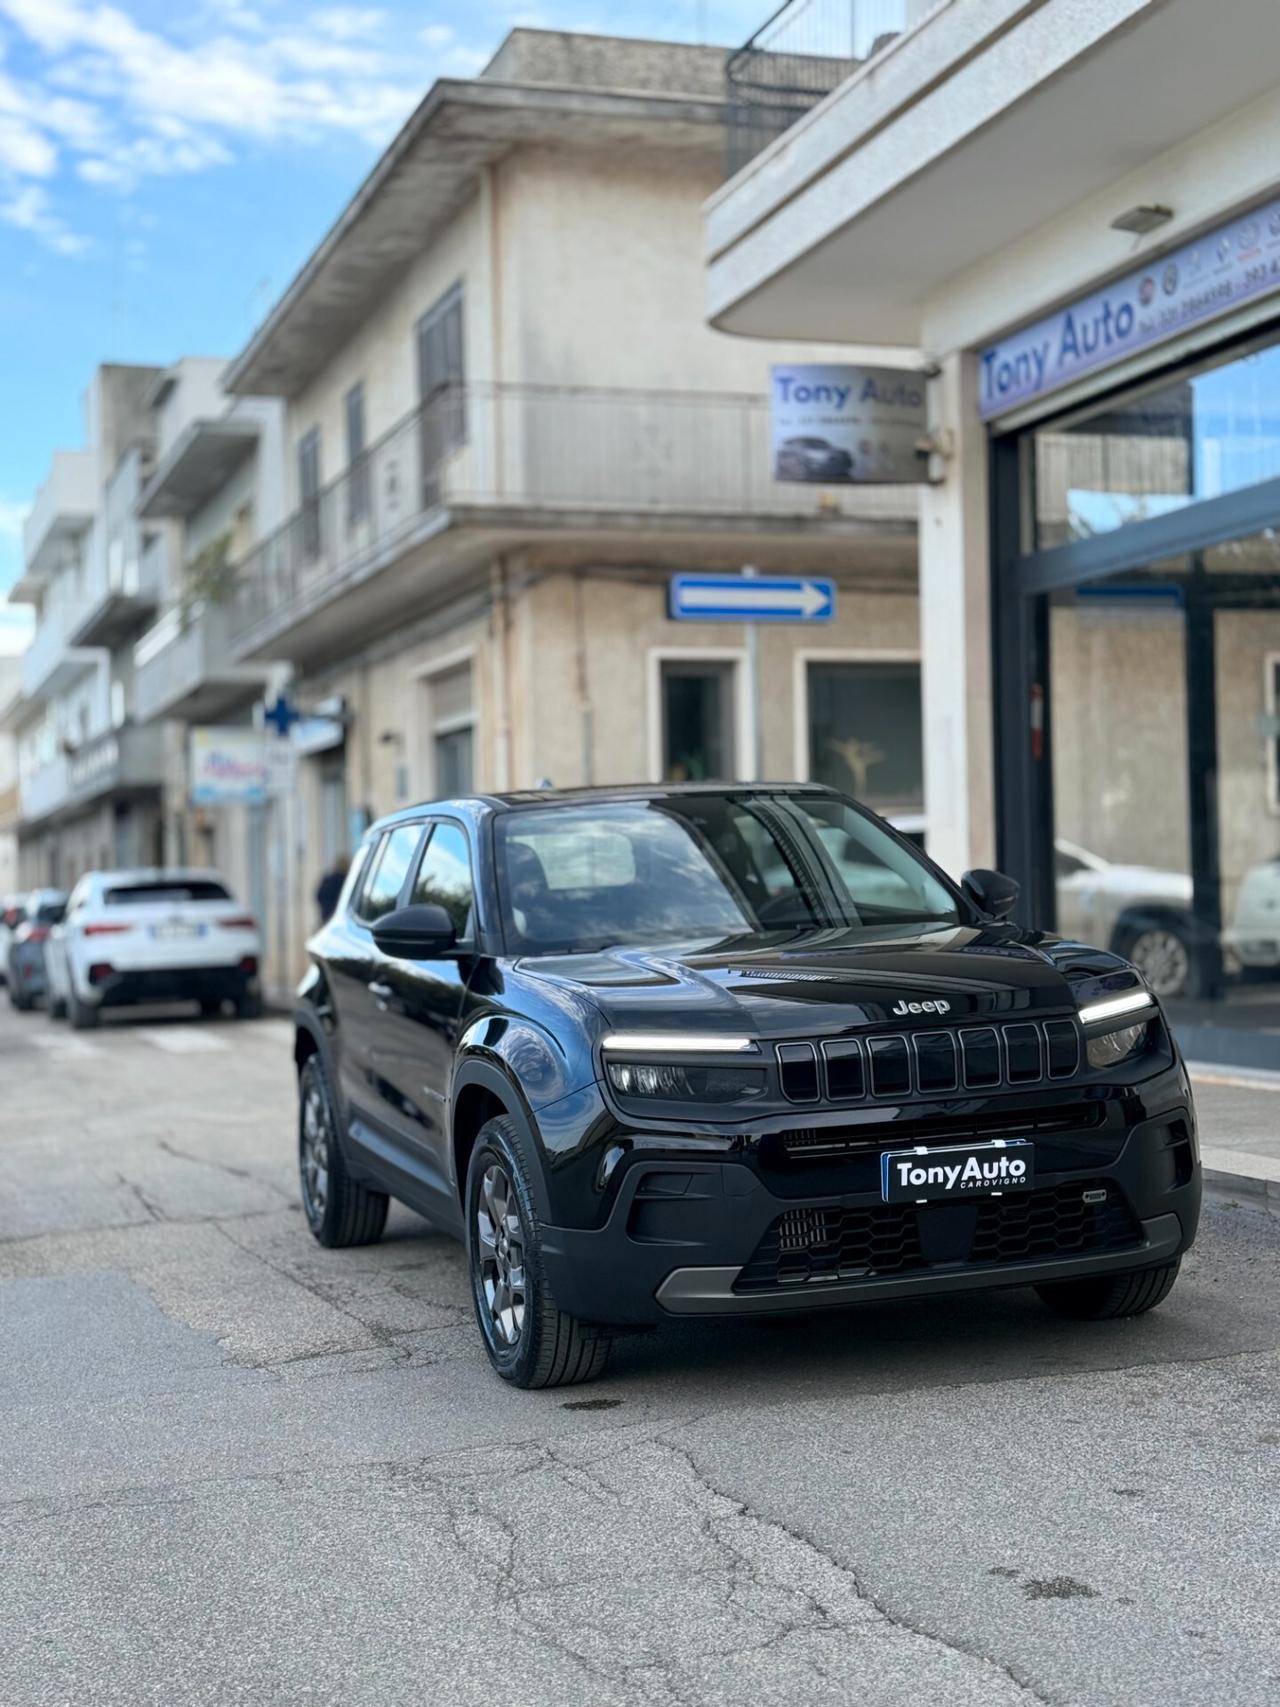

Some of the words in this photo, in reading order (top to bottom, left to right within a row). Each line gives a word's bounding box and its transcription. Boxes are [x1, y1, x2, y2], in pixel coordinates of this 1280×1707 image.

[981, 341, 1050, 400] Tony
[1058, 301, 1133, 367] Auto
[776, 377, 849, 410] Tony
[860, 378, 923, 407] Auto
[892, 999, 951, 1016] Jeep
[960, 1176, 1026, 1189] CAROVIGNO
